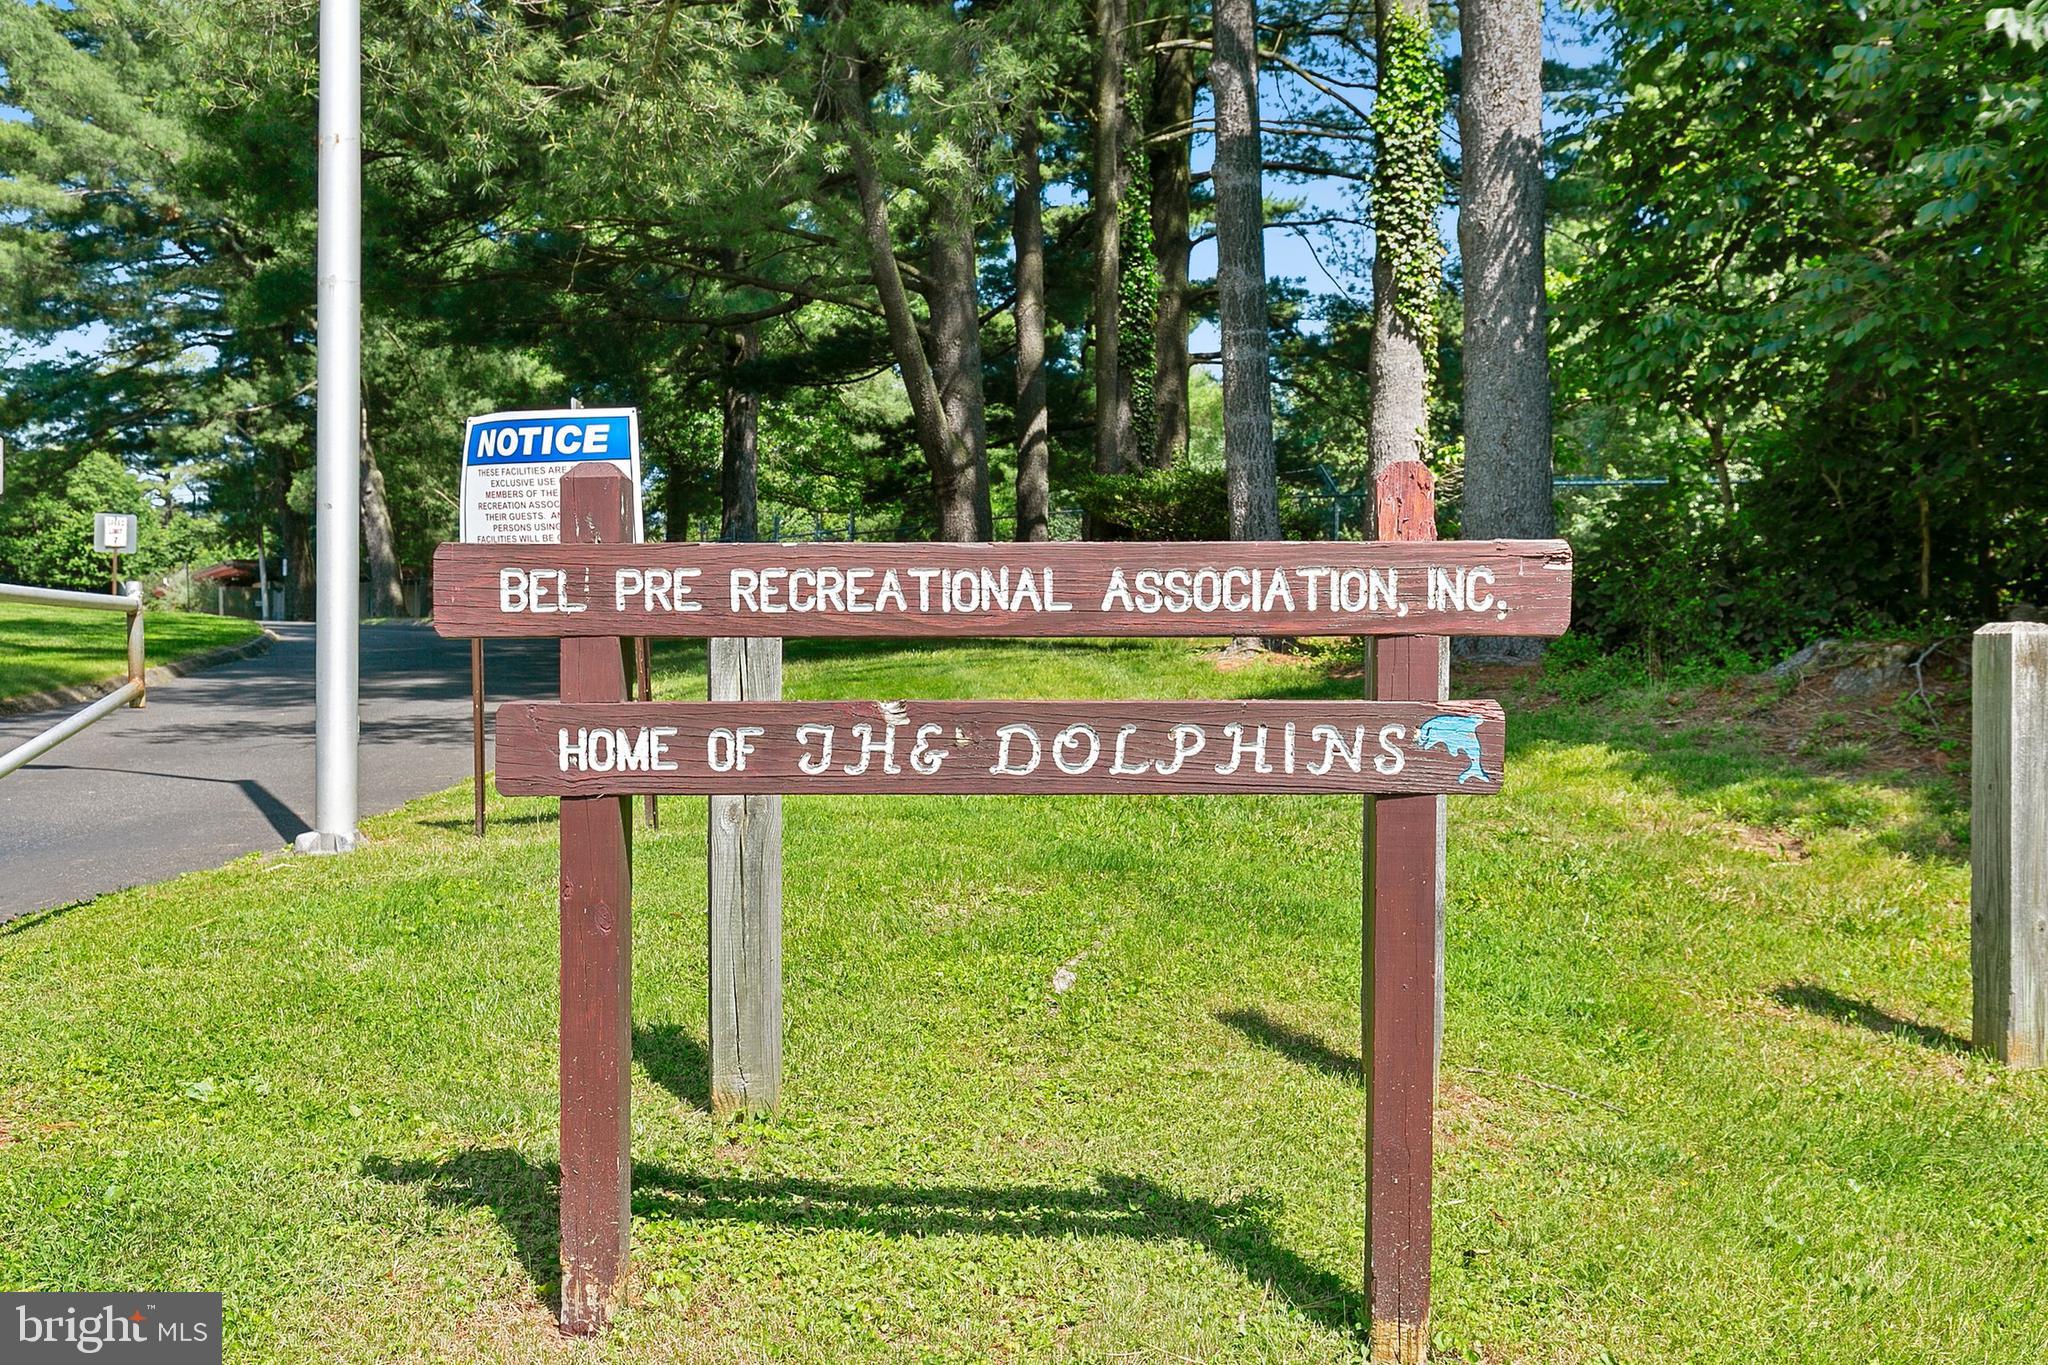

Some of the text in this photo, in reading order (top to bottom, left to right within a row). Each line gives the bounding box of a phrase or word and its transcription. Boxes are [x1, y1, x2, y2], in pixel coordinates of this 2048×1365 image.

[477, 424, 610, 458] NOTICE
[478, 468, 499, 477] THESE
[501, 466, 546, 476] FACILITIES
[548, 466, 567, 474] ARE
[490, 478, 556, 487] EXCLUSIVE USE
[485, 489, 558, 498] MEMBERS OF THE
[478, 501, 527, 510] RECREATION
[485, 513, 507, 521] THEIR
[493, 523, 532, 532] PERSONS
[477, 535, 517, 544] FACILITIES
[519, 534, 540, 543] WILL
[542, 534, 554, 542] BE
[500, 567, 588, 614] BEL
[615, 567, 703, 613] PRE
[730, 566, 1073, 614] RECREATIONAL
[1101, 566, 1409, 618] ASSOCIATION,
[558, 726, 679, 773] HOME
[707, 726, 765, 773] OF
[989, 721, 1406, 776] DOLPHINS
